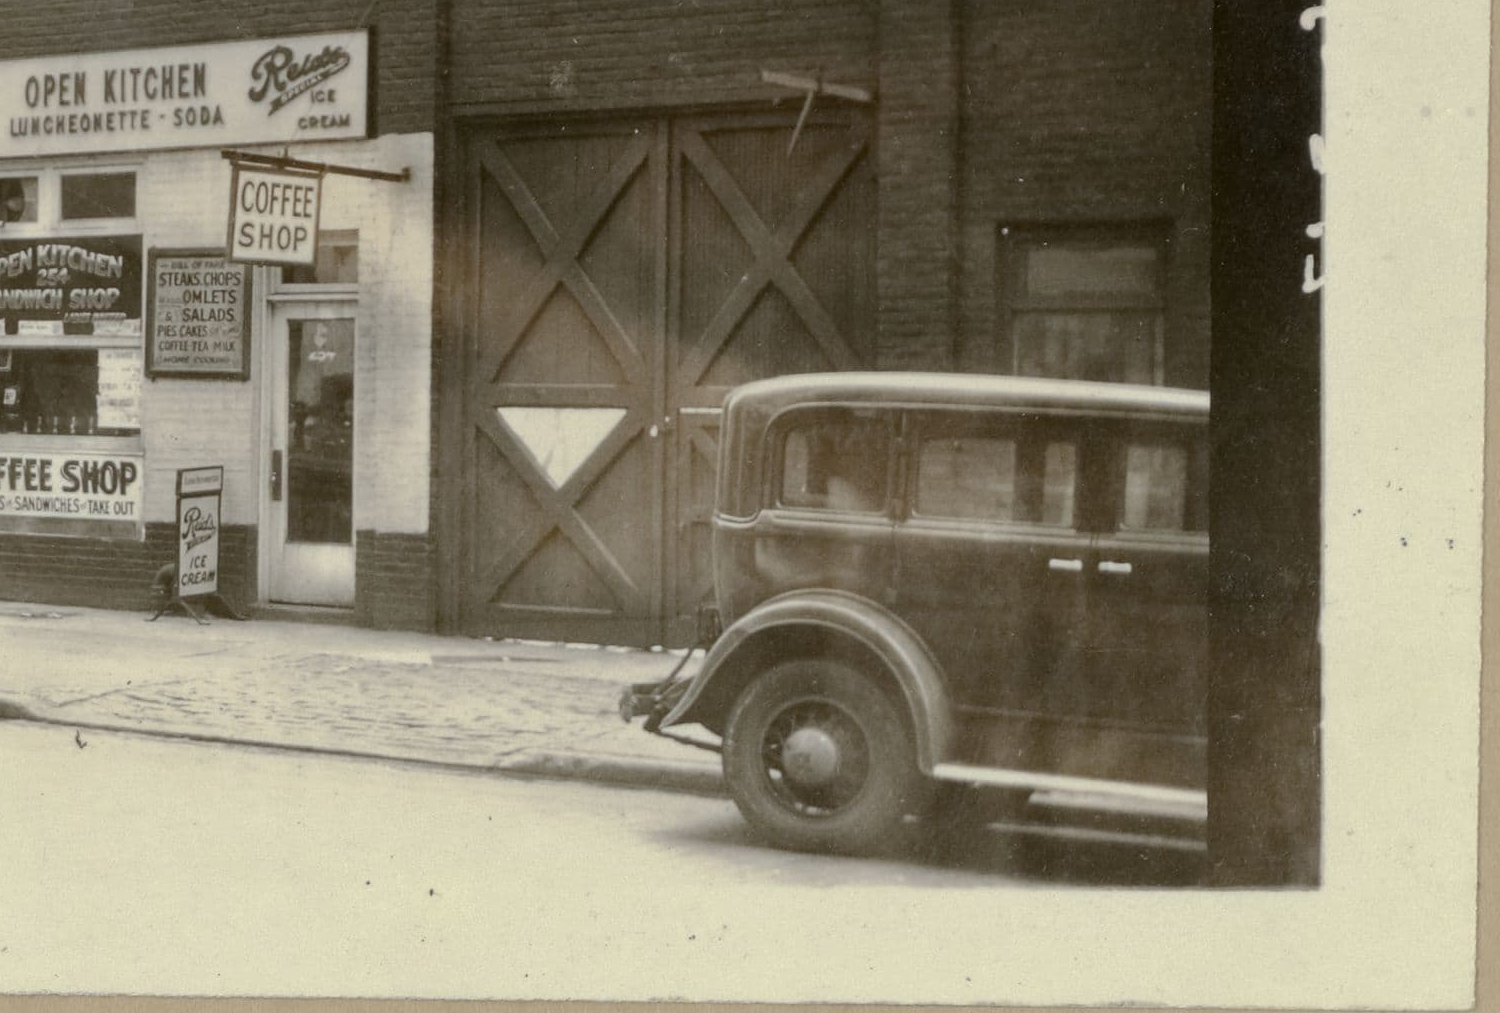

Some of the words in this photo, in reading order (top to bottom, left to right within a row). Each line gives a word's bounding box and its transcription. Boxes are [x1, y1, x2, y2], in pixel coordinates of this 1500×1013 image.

[25, 71, 86, 108] OPEN
[103, 61, 206, 104] KITCHEN
[310, 86, 336, 103] ICE
[10, 109, 151, 137] LUNCHEONETTE
[173, 104, 225, 127] SODA
[298, 113, 350, 130] CREAM
[241, 180, 314, 218] COFFEE
[238, 222, 308, 252] SHOP
[36, 244, 123, 279] KITCHEN
[203, 272, 241, 287] CHOPS
[69, 287, 120, 309] SHOP
[183, 290, 236, 304] OMLETS
[182, 308, 235, 322] SALADS
[157, 325, 177, 336] PIES
[180, 325, 207, 337] CAKES
[159, 341, 188, 352] COFFEE
[213, 341, 236, 351] MILK
[60, 460, 137, 495] SHOP
[15, 496, 79, 513] SANDWICHES
[88, 500, 109, 514] TAKE
[113, 501, 135, 515] OUT
[189, 555, 207, 568] ICE
[181, 570, 215, 586] CREAM
